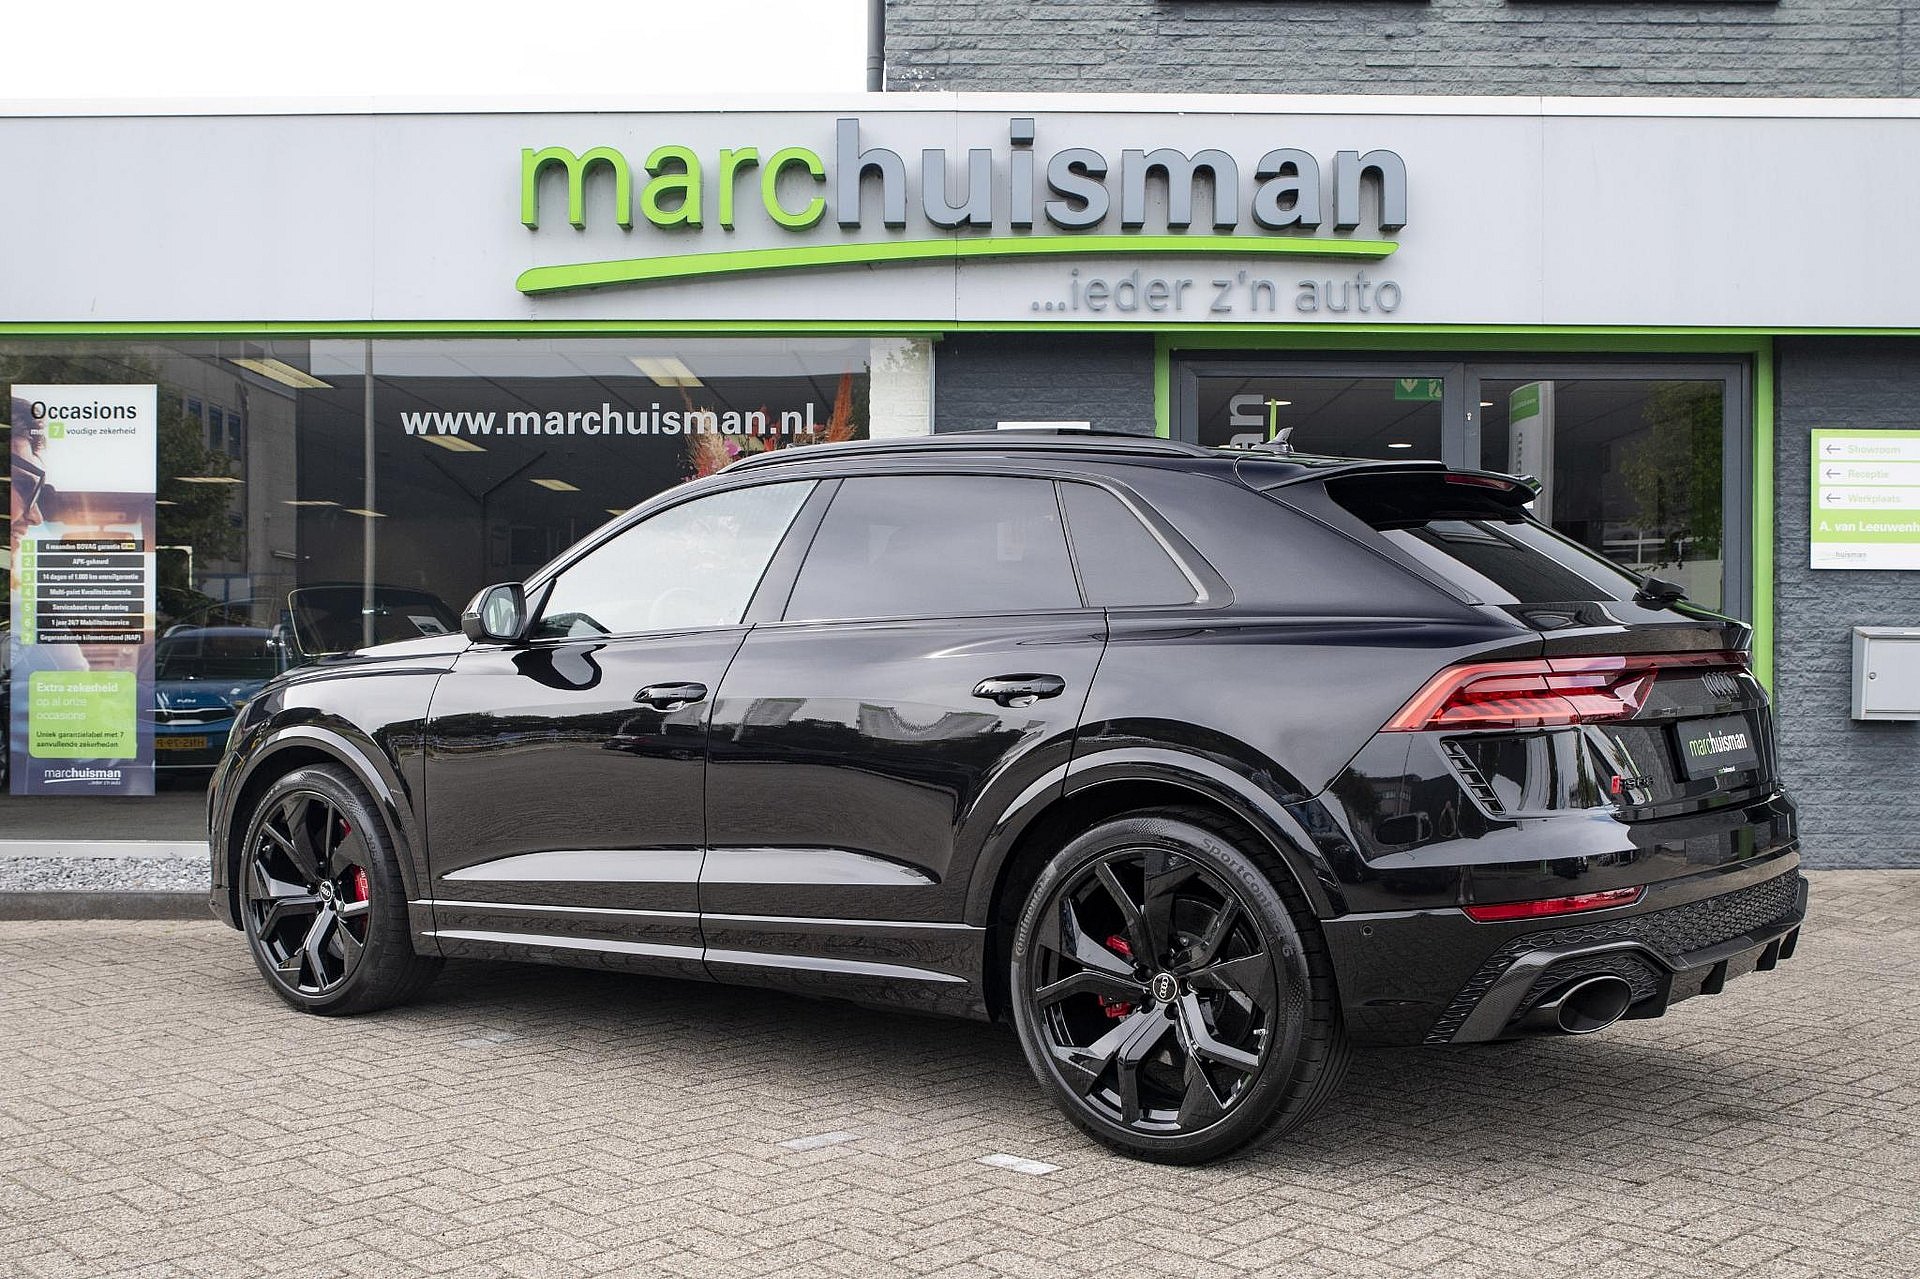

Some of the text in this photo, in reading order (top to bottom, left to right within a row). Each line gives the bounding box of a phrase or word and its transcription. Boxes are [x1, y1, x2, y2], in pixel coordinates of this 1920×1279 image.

[520, 118, 1408, 231] marchuisman
[1031, 268, 1403, 314] ...ieder z'n auto
[31, 401, 137, 419] Occasions
[401, 402, 815, 435] www.marchuisman.nl
[66, 427, 98, 436] voudige
[99, 427, 136, 435] zekerheid
[1847, 444, 1901, 455] Showroom
[1847, 469, 1889, 480] Receptie
[1820, 521, 1831, 532] A.
[1835, 523, 1855, 532] van
[37, 681, 119, 693] Extra zekerheid
[1688, 729, 1748, 758] marchuisman
[44, 767, 122, 778] marchuisman
